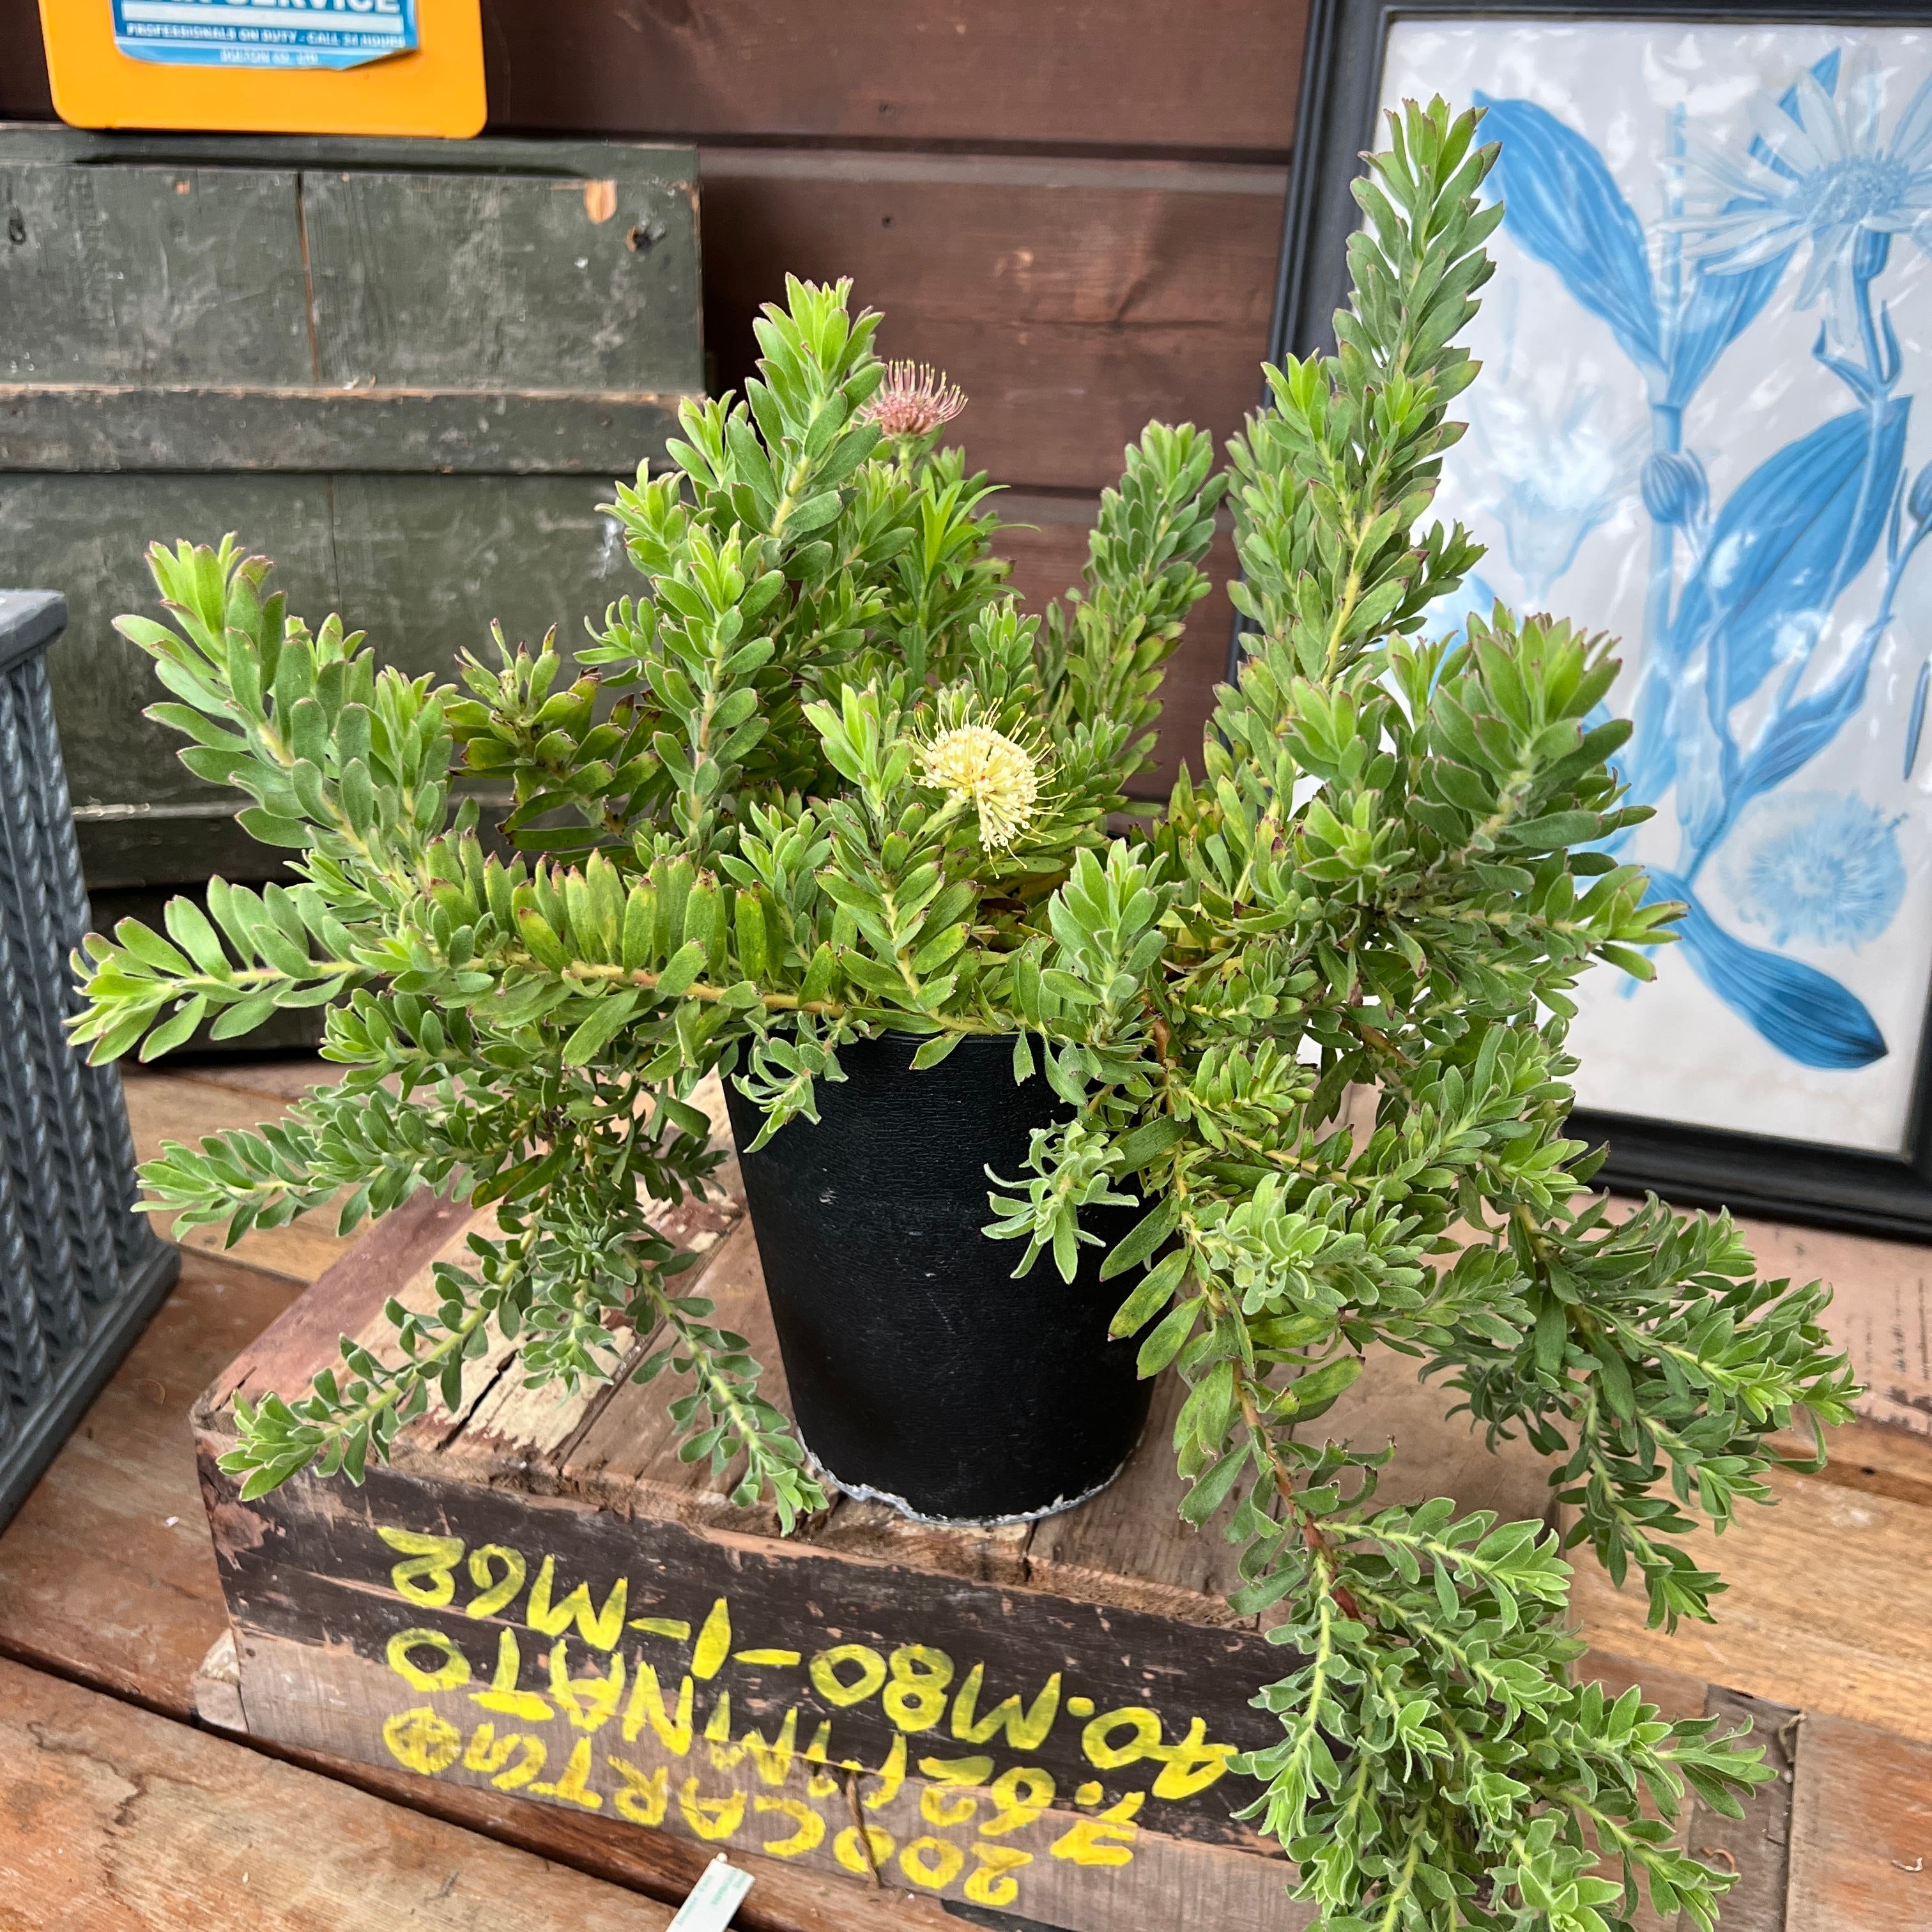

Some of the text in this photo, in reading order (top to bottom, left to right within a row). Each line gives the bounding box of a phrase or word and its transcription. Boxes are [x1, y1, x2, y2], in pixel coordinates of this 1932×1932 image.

[126, 22, 237, 40] PROFESSIONALS
[238, 27, 259, 42] ON
[260, 28, 297, 45] DUTY
[306, 31, 339, 47] CALL
